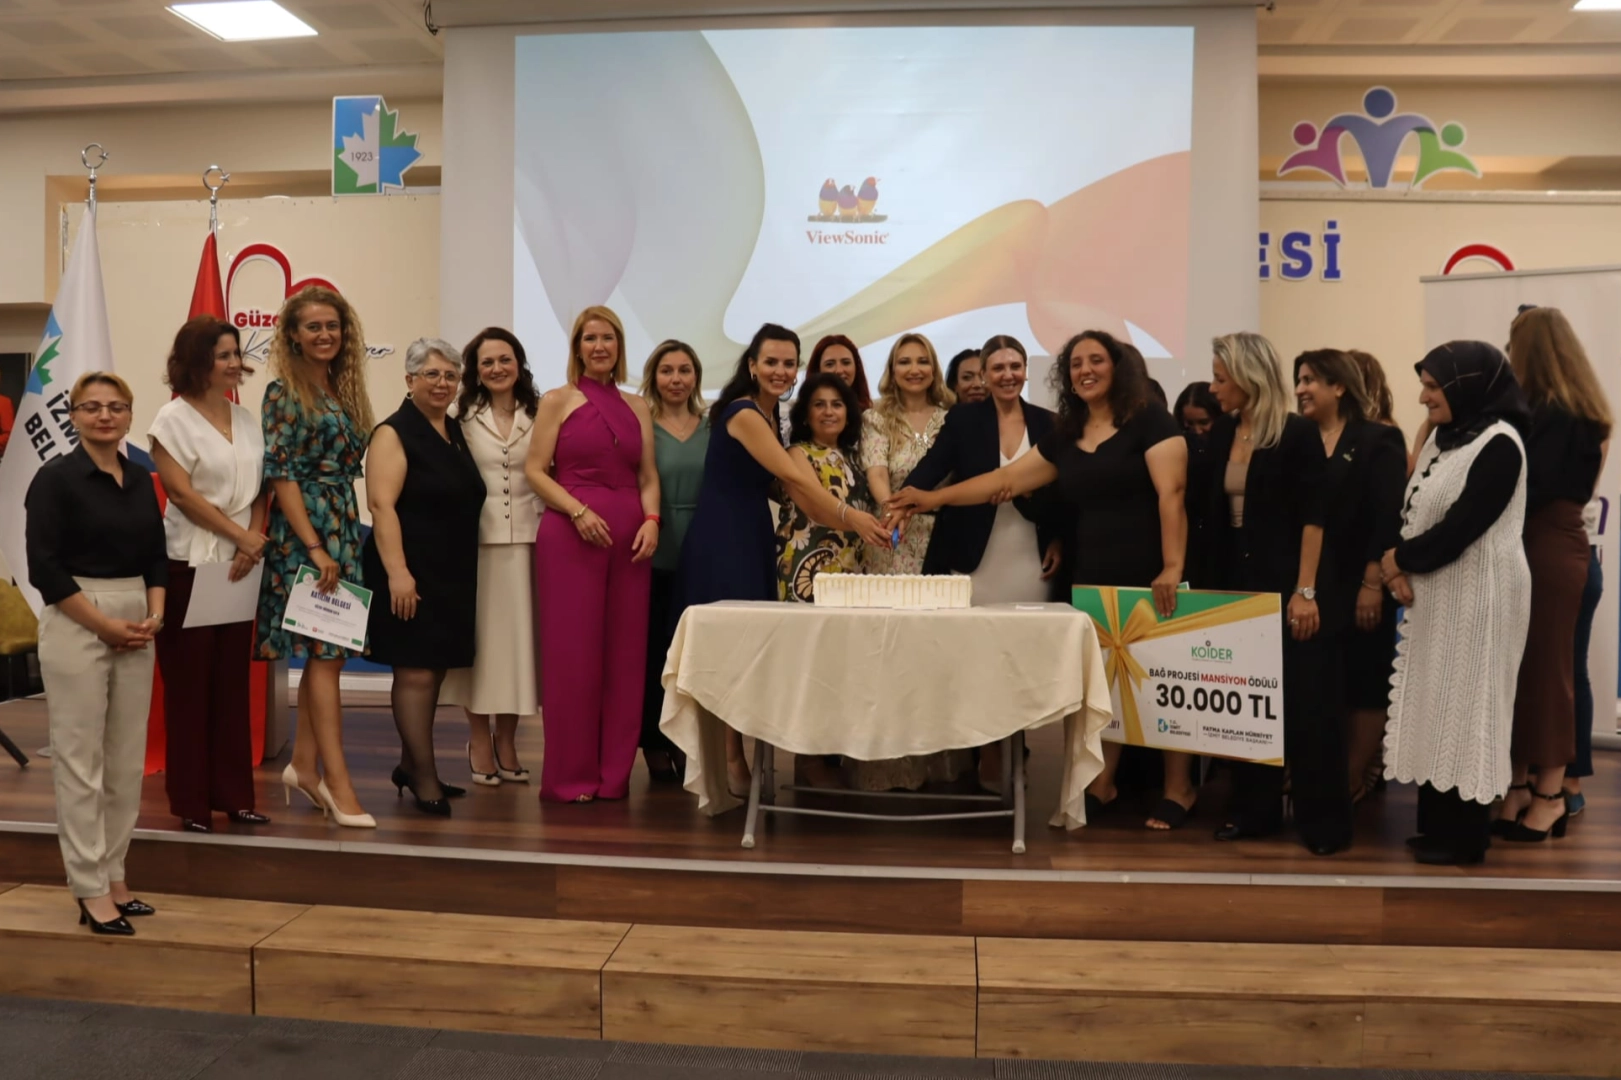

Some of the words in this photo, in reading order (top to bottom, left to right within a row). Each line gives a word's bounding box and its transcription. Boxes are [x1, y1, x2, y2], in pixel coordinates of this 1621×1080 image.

[351, 152, 373, 161] 1923
[806, 230, 888, 244] ViewSonic
[24, 412, 60, 462] BEL
[1149, 667, 1166, 678] BAĞ
[1167, 670, 1200, 681] PROJESİ
[1201, 673, 1247, 686] MANSİYON
[1248, 675, 1278, 689] ÖDÜLÜ
[1156, 683, 1242, 715] 30.000
[1248, 694, 1277, 720] TL
[1221, 728, 1244, 736] KAPLAN
[1245, 731, 1273, 740] HÜRRİYET
